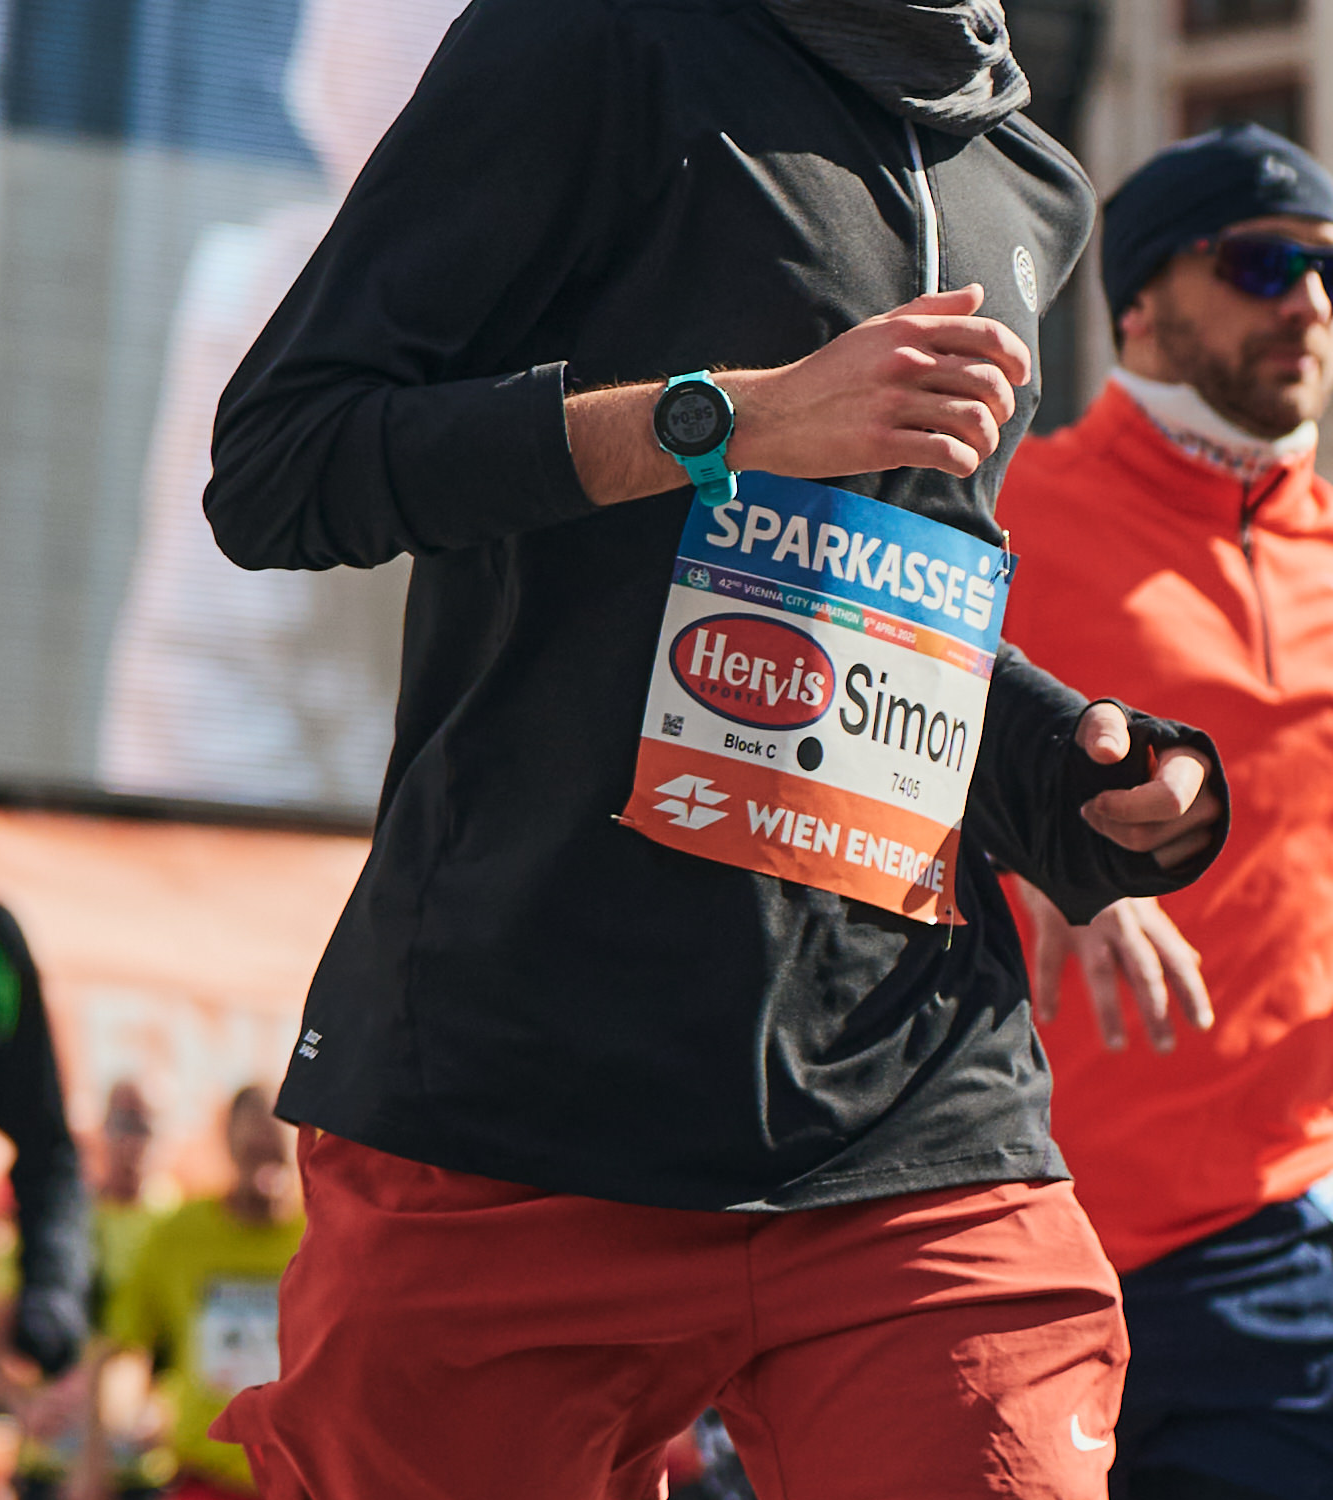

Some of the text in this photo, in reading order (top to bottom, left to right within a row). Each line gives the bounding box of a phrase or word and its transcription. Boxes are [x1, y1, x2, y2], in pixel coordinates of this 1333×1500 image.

[705, 500, 965, 617] SPARKASSE
[744, 583, 783, 603] VIENNA
[785, 594, 809, 609] CITY
[810, 601, 861, 624] MARATHON
[875, 621, 897, 637] APRIL
[897, 628, 918, 644] 2025
[689, 628, 826, 707] Hervis
[699, 682, 764, 707] SPORTS
[724, 733, 777, 759] Block C
[838, 662, 967, 772] Simon
[890, 771, 921, 800] 7405
[746, 799, 944, 894] WIEN ENERGIE
